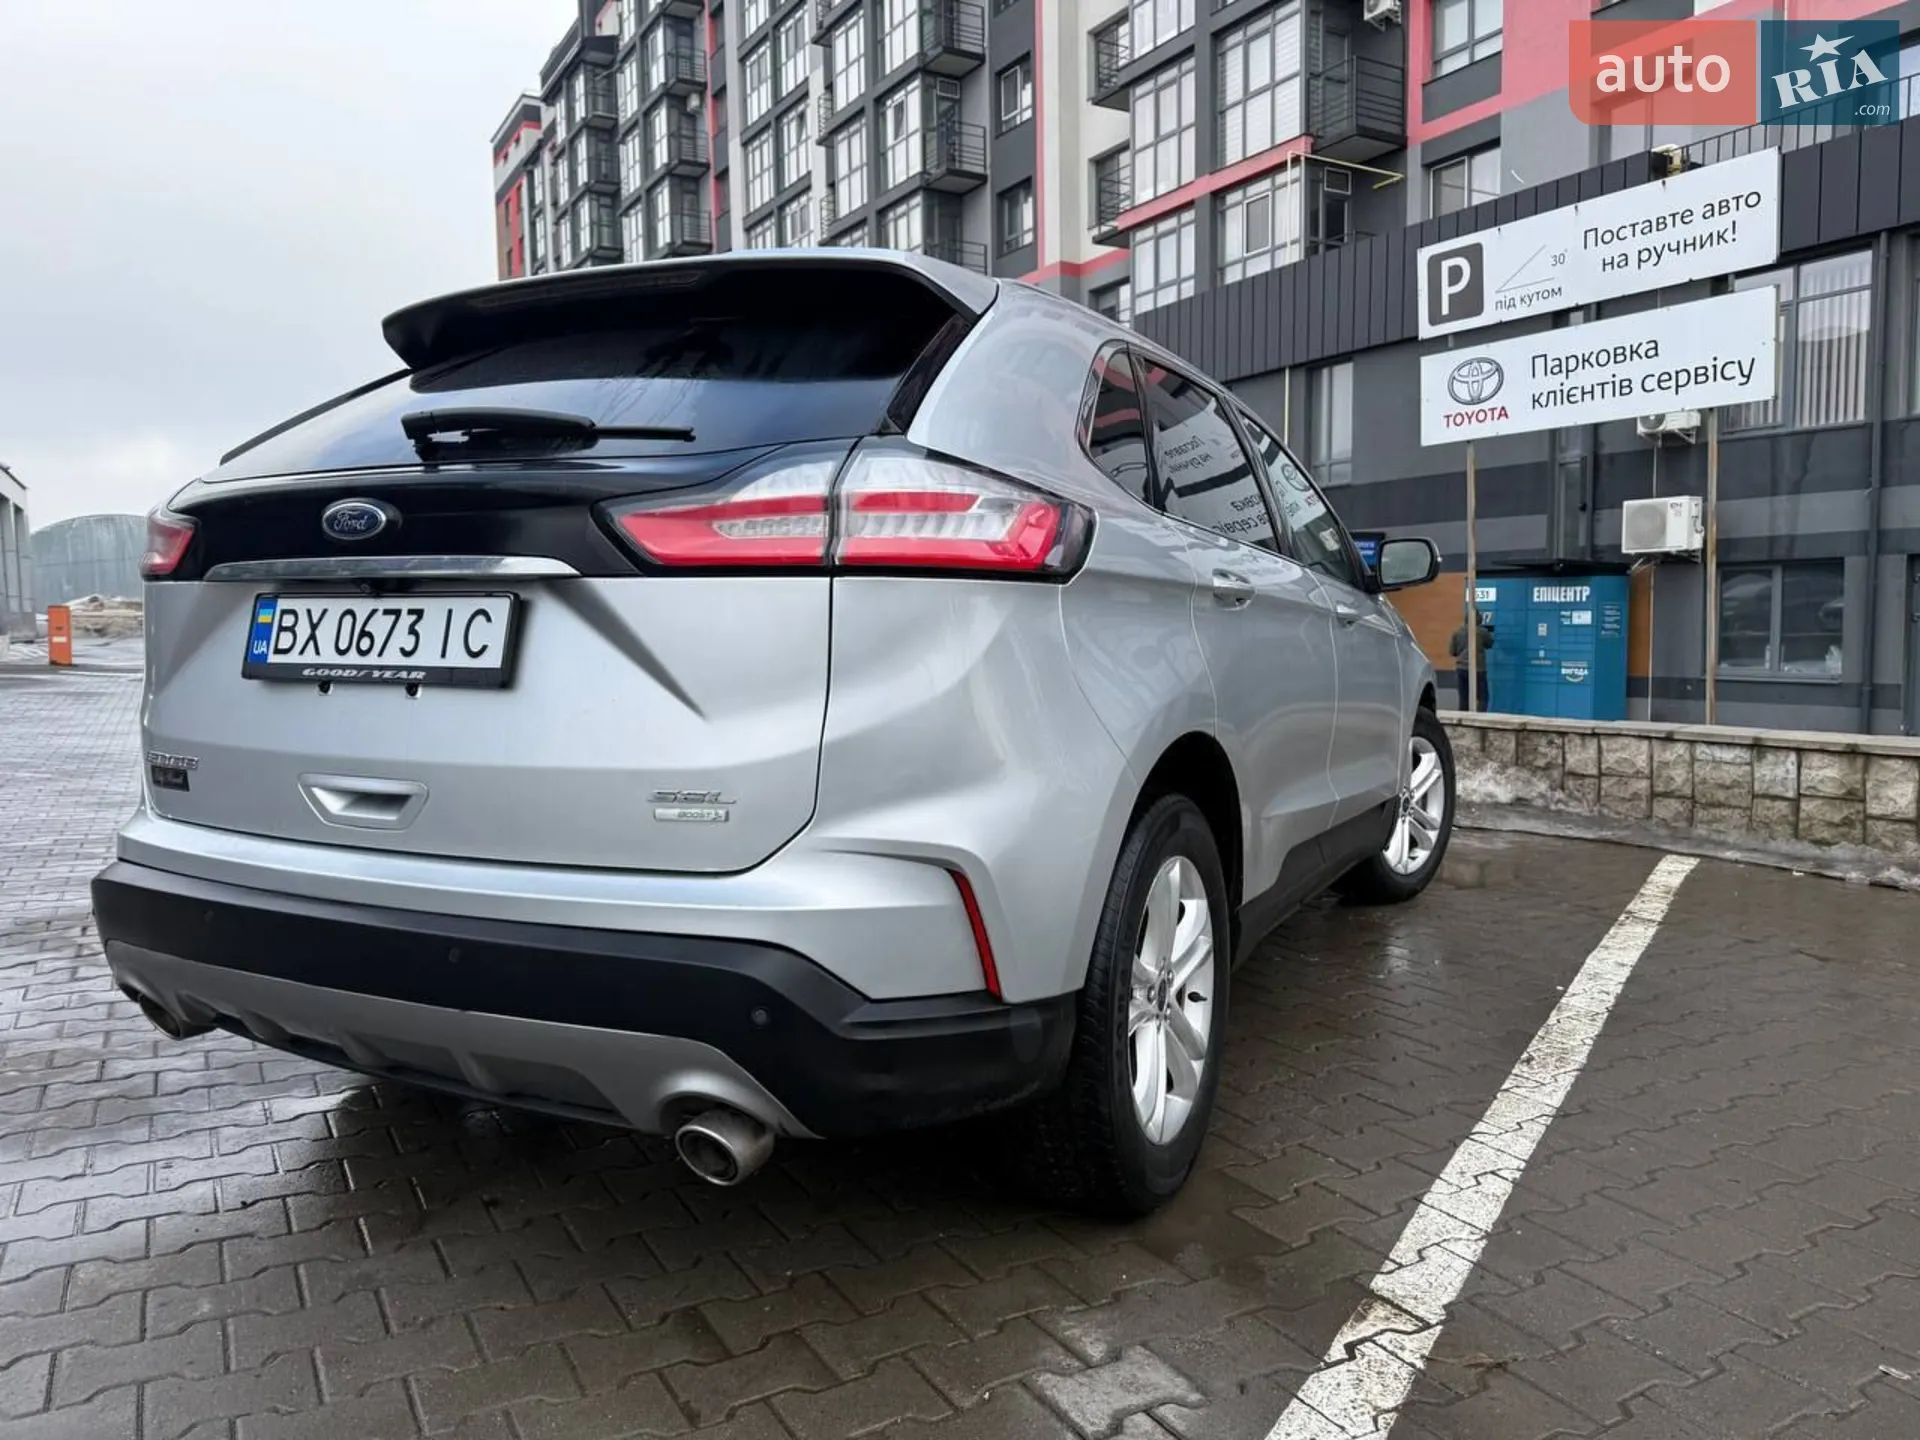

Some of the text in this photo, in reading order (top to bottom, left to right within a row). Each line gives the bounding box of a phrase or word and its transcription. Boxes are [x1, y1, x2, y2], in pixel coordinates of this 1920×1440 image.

[1583, 190, 1762, 250] Поставте авто
[1601, 219, 1738, 272] на ручник!
[1440, 256, 1471, 316] P
[1495, 285, 1563, 312] під кутом
[1531, 338, 1660, 382] Парковка
[1531, 356, 1757, 410] клієнтів сервісу
[1443, 405, 1509, 428] TOYOTA
[333, 509, 368, 531] Ford
[1533, 586, 1591, 603] ЕПІЦЕНТР
[253, 640, 268, 655] UA
[273, 607, 492, 659] BX 0673 IC
[302, 667, 426, 680] GOODYEAR
